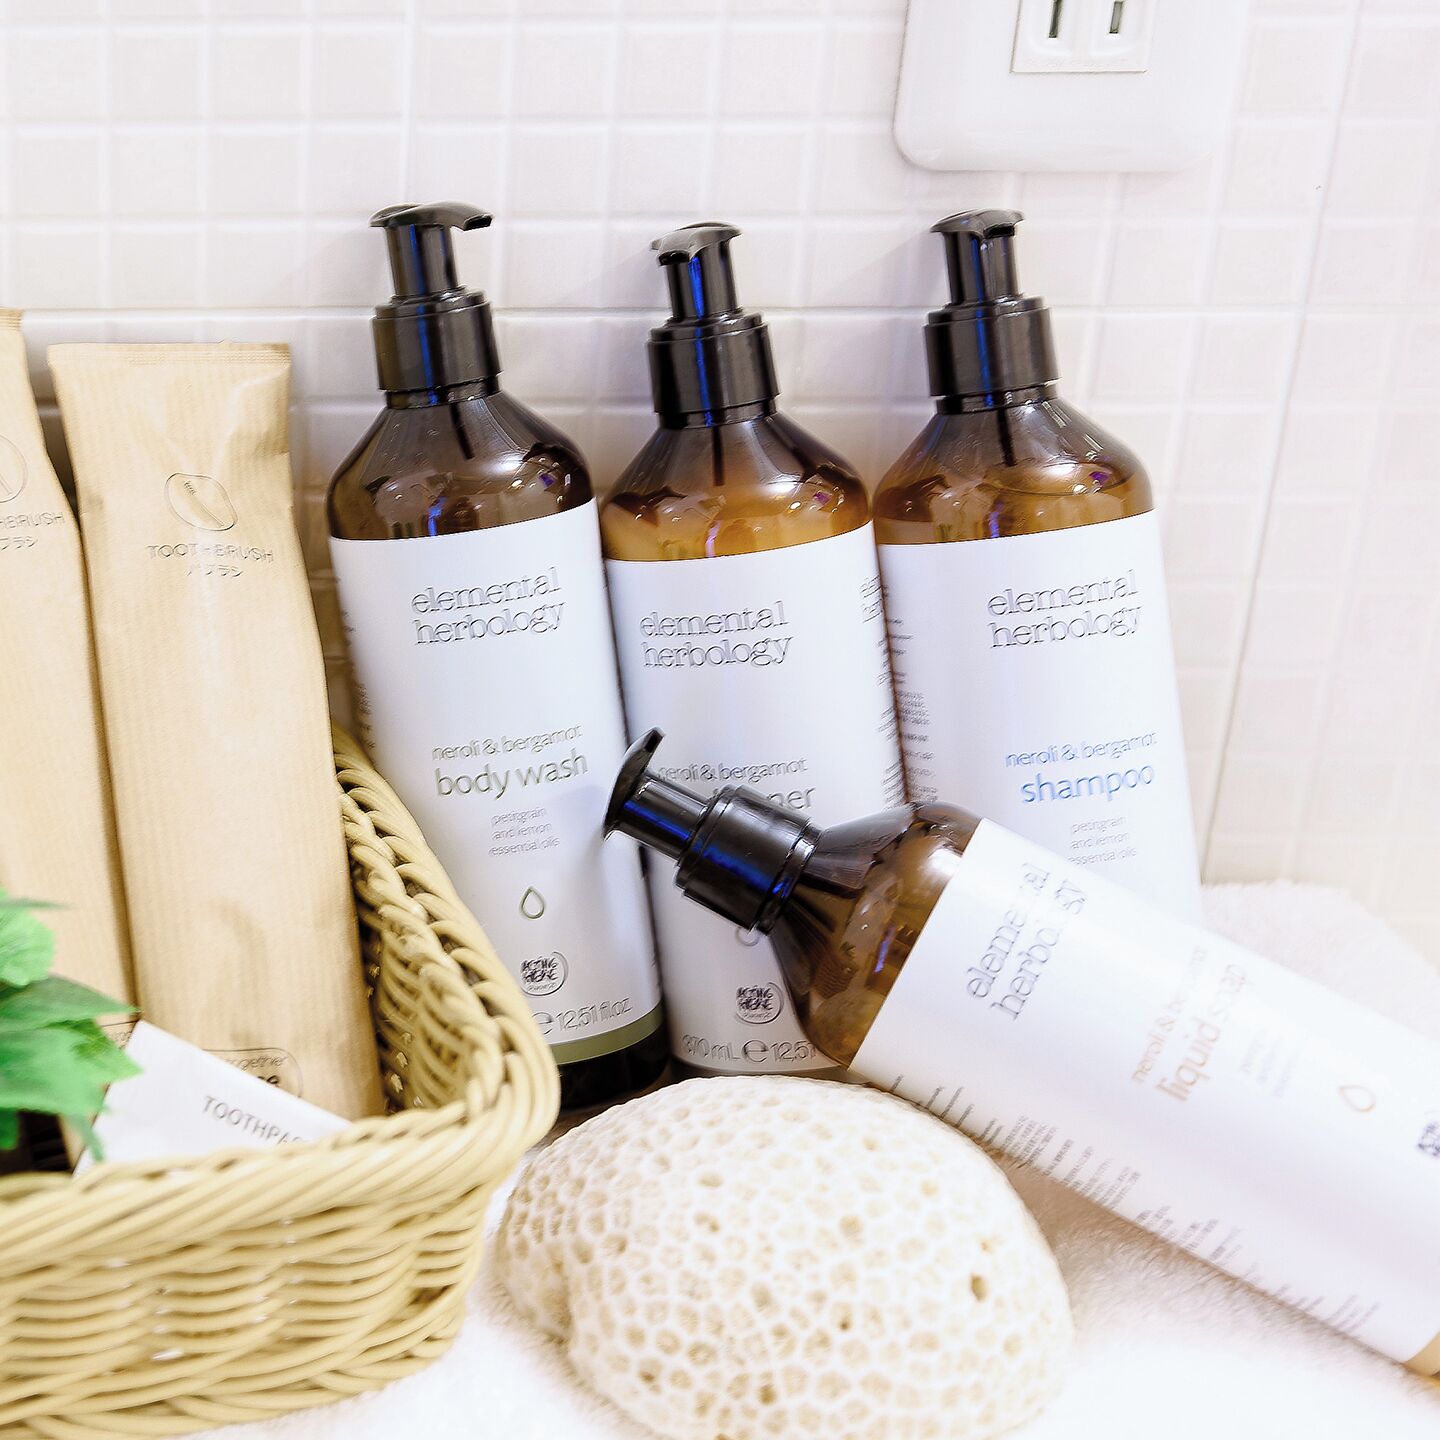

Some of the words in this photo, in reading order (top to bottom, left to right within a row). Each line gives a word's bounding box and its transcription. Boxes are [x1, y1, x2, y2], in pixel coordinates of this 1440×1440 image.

[146, 543, 274, 562] TOOTHBRUSH
[412, 566, 562, 613] elemental
[987, 568, 1139, 616] elemental
[412, 601, 566, 645] herbology
[639, 600, 790, 637] elemental
[987, 606, 1142, 649] herbology
[641, 637, 794, 668] herbology
[432, 739, 480, 761] neroli
[482, 738, 500, 754] &
[501, 723, 583, 753] bergamot
[1005, 745, 1057, 767] neroli
[1061, 744, 1079, 761] &
[1081, 732, 1158, 759] bergamot
[435, 763, 510, 800] body
[515, 747, 588, 787] wash
[700, 764, 717, 780] &
[718, 758, 809, 783] bergamot
[1021, 765, 1155, 803] shampoo
[966, 862, 1051, 998] elemeal
[990, 878, 1088, 1021] herbogy
[1155, 1015, 1221, 1102] liquid
